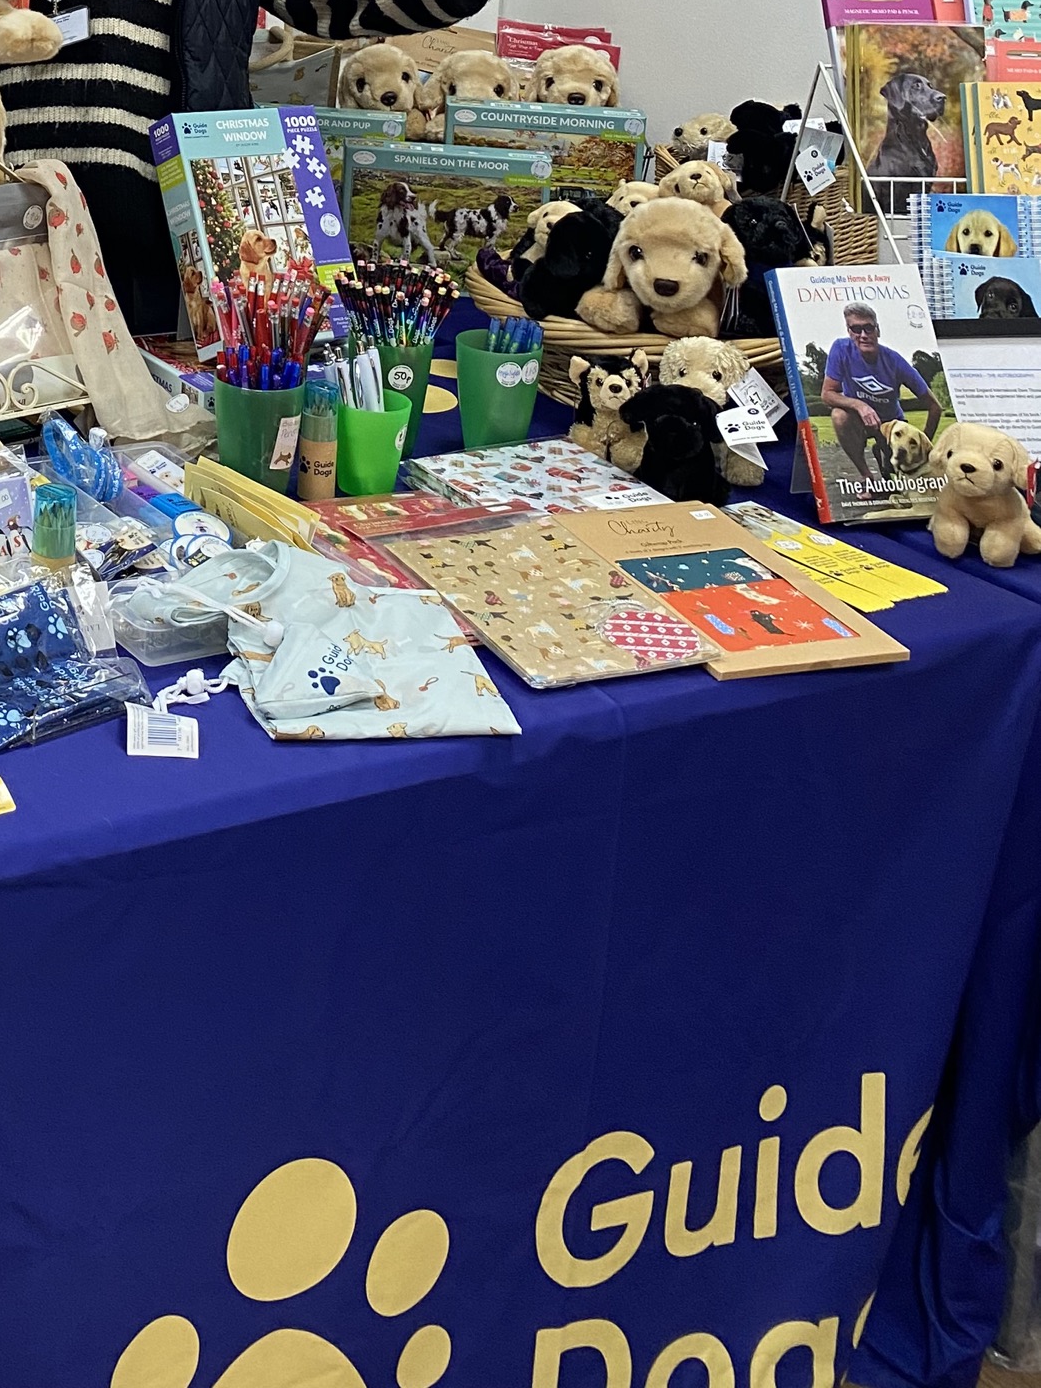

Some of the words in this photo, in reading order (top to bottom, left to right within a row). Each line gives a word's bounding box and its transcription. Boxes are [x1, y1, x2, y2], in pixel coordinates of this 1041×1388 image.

[508, 36, 538, 46] Christmas
[215, 117, 270, 130] CHRISTMAS
[284, 115, 316, 128] 1000
[480, 111, 557, 126] COUNTRYSIDE
[559, 117, 615, 130] MORNING
[153, 123, 170, 138] 1000
[223, 131, 268, 143] WINDOW
[394, 154, 438, 167] SPANIELS
[440, 157, 455, 166] ON
[458, 159, 476, 169] THE
[477, 160, 509, 171] MOOR
[811, 161, 825, 174] Guide
[813, 167, 827, 176] Dogs
[810, 276, 836, 285] Guiding
[874, 275, 891, 283] Away
[313, 461, 335, 469] Guide
[313, 469, 333, 479] Dogs
[836, 478, 863, 494] The
[866, 474, 949, 493] Autobiograp
[622, 491, 649, 499] Guide
[608, 519, 675, 537] Charity
